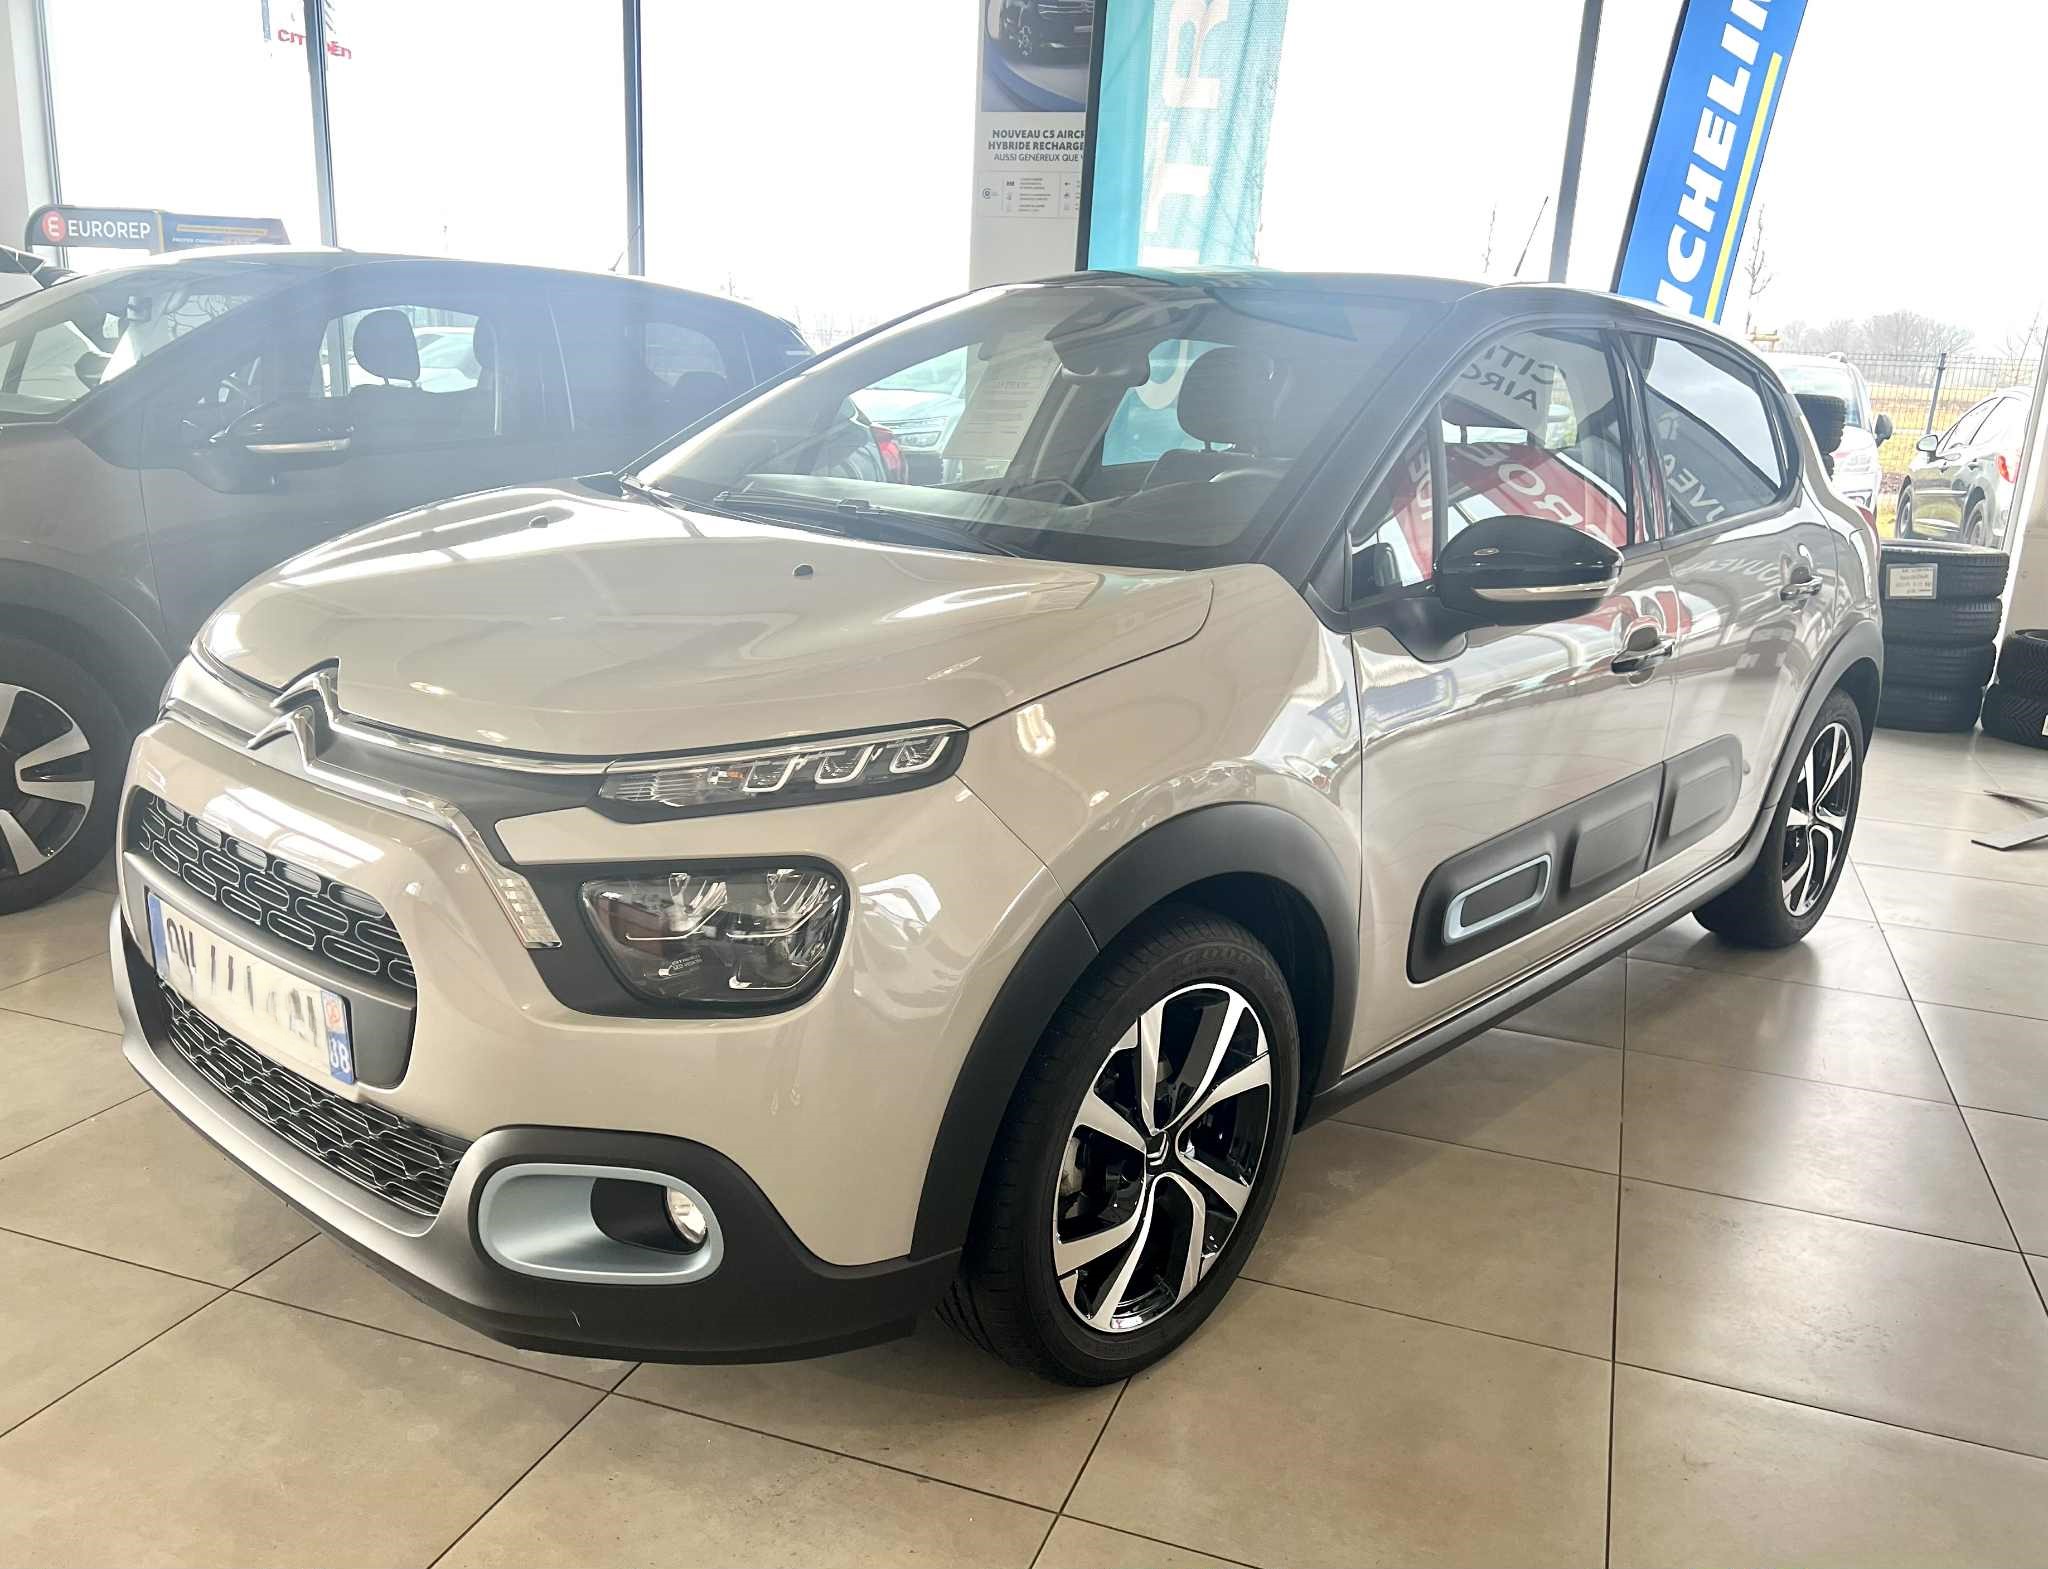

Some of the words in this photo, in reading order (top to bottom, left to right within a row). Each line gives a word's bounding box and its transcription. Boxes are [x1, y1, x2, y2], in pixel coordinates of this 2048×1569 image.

[992, 129, 1040, 139] NOUVEAU
[1043, 129, 1055, 139] C5
[988, 141, 1030, 150] HYBRIDE
[993, 153, 1017, 161] AUSSI
[1062, 153, 1079, 162] QUE
[67, 219, 150, 240] EUROREP
